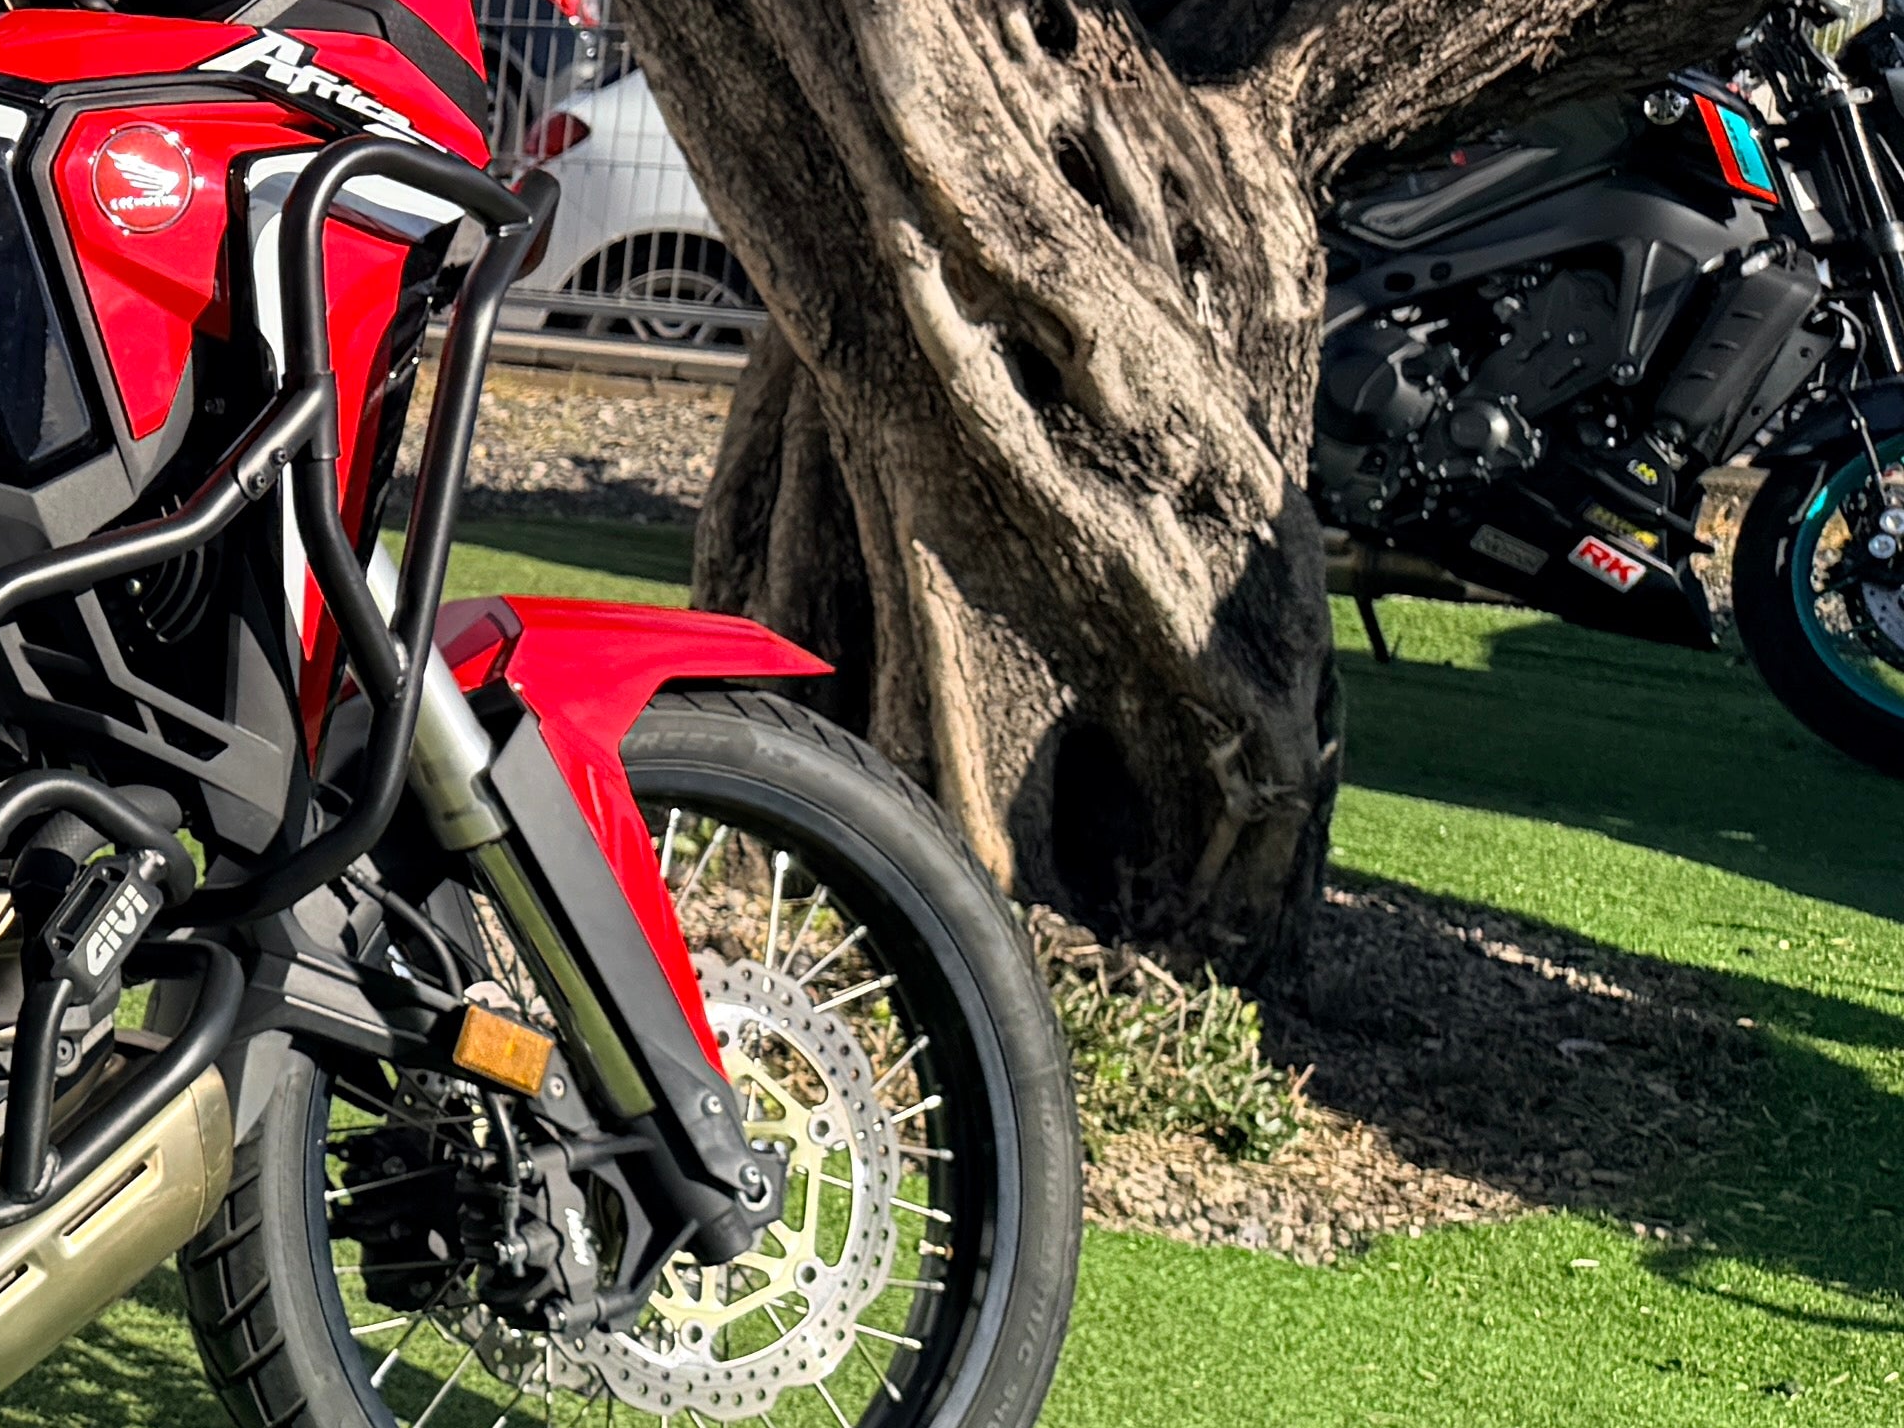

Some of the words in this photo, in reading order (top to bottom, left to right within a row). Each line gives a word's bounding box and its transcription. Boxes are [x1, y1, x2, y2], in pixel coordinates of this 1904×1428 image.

[198, 27, 413, 130] Africa
[1577, 541, 1638, 585] RK
[85, 882, 149, 977] GIVI
